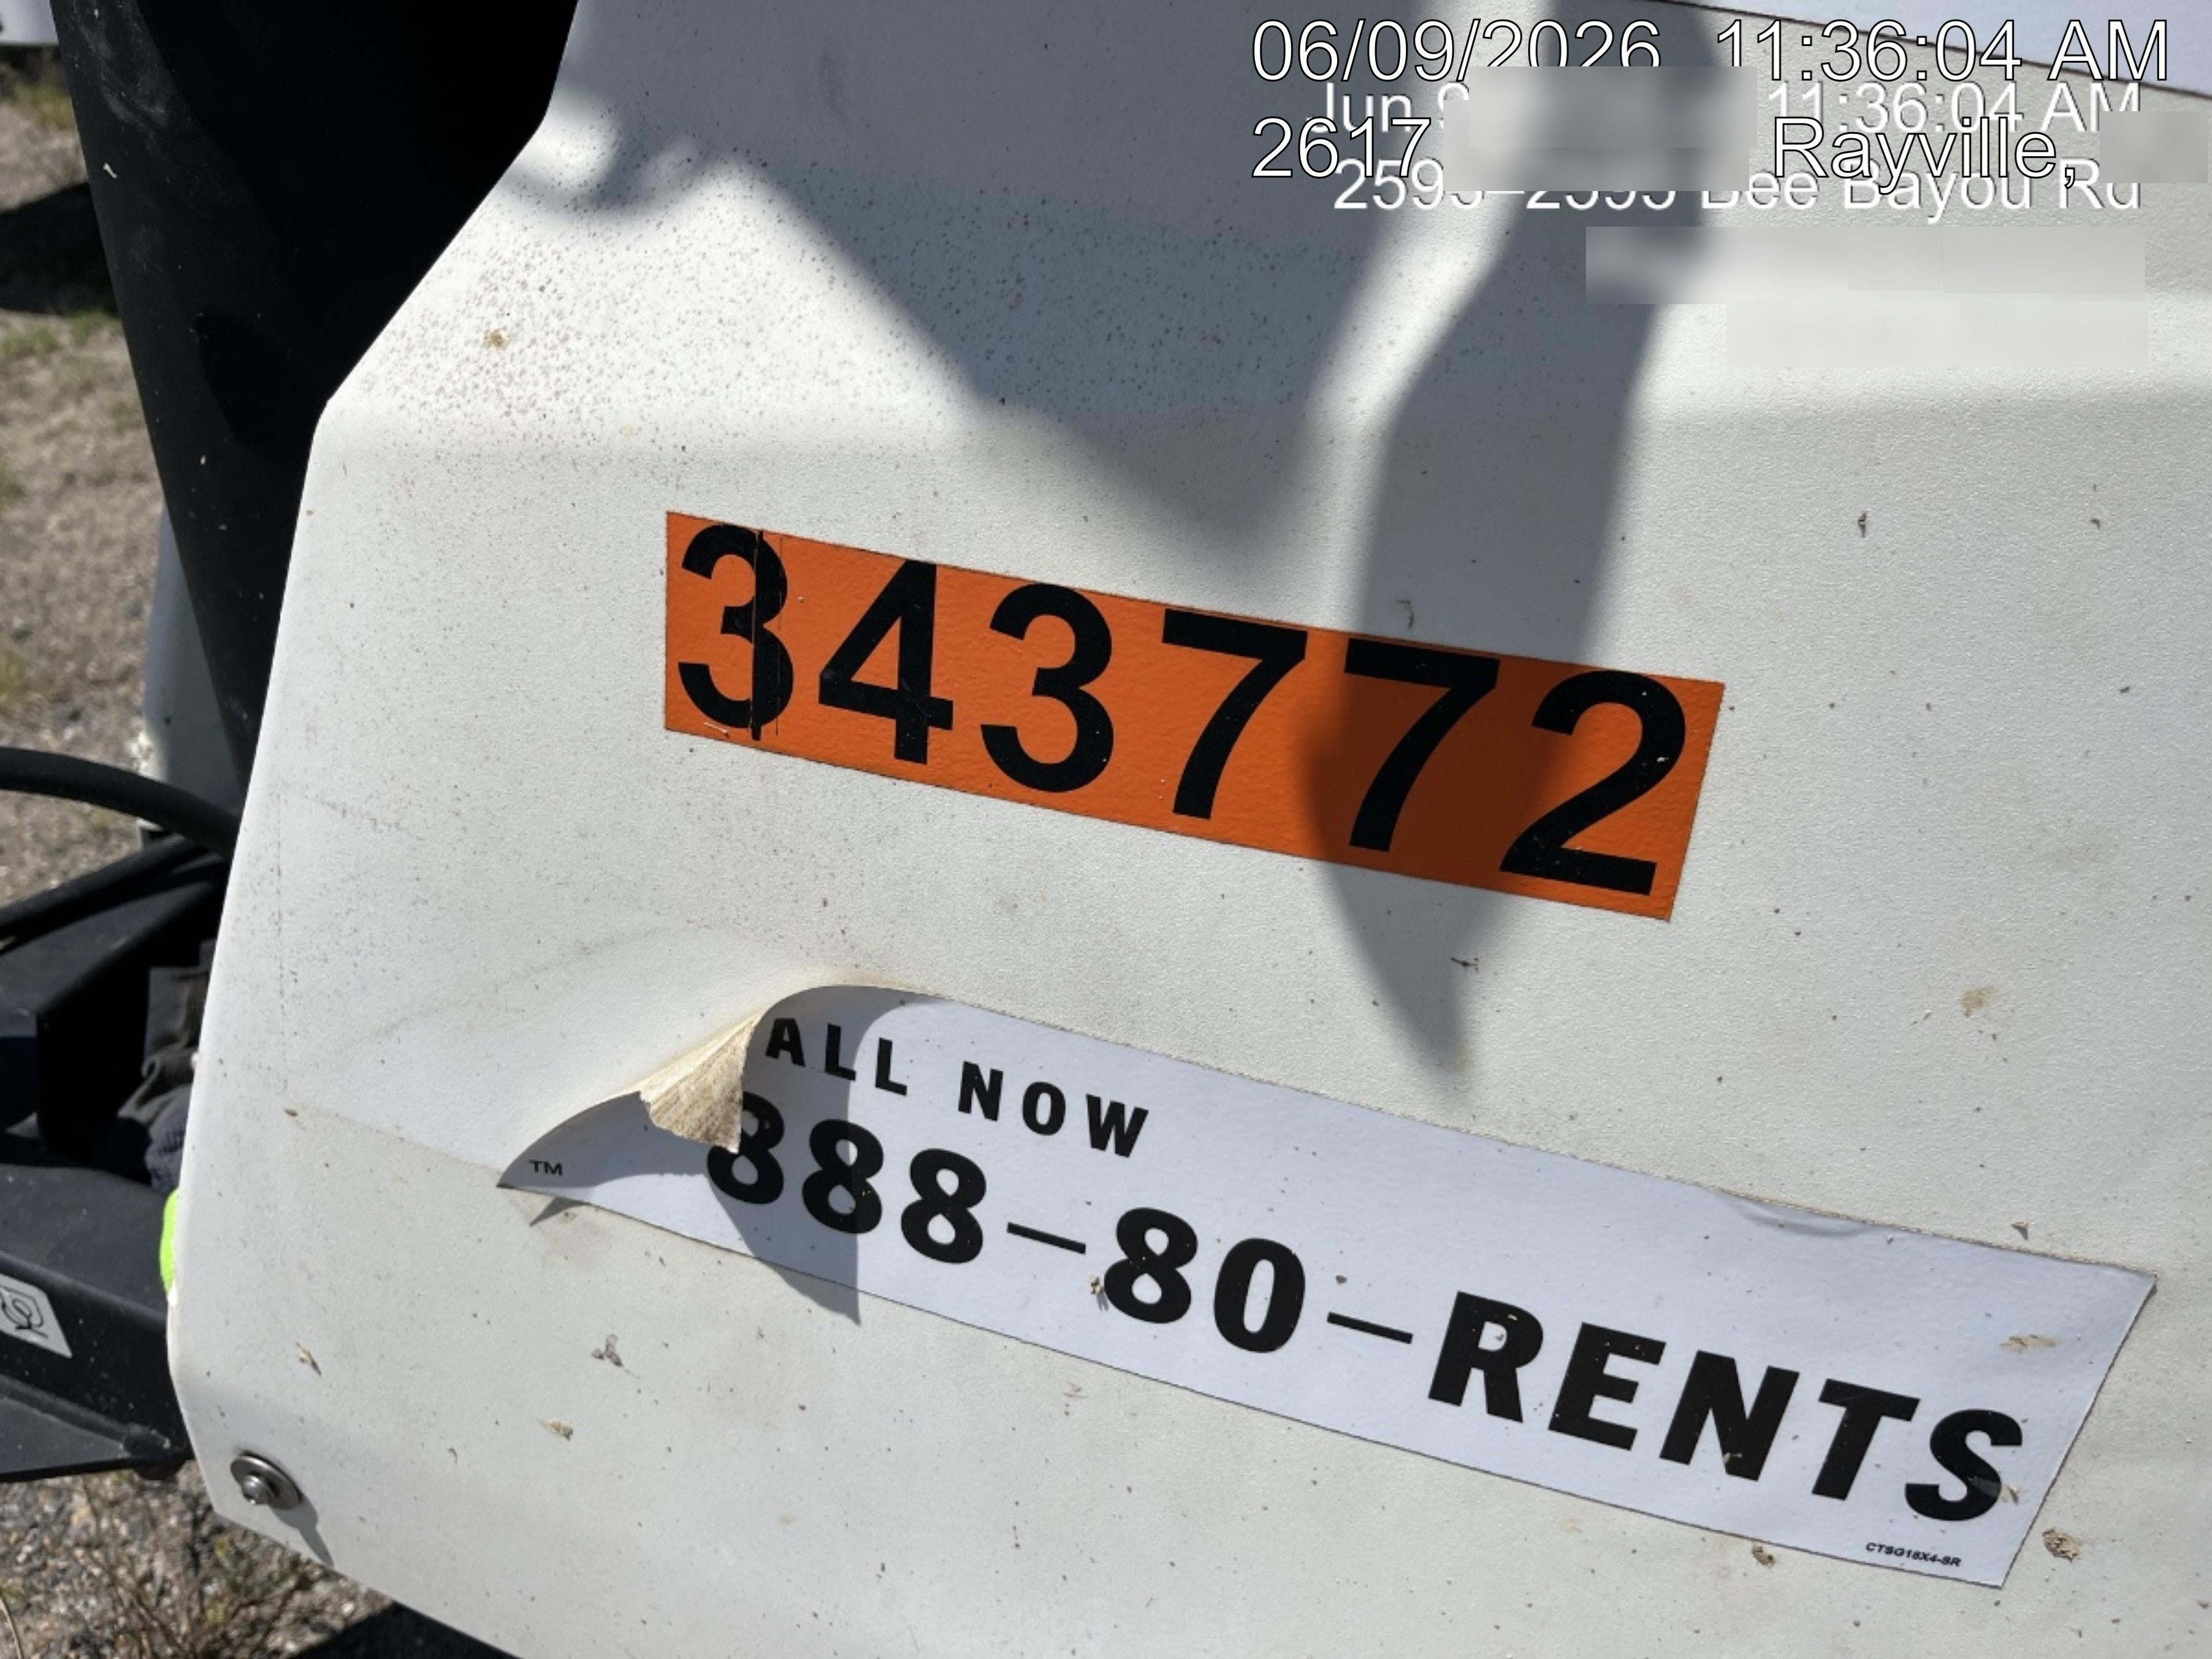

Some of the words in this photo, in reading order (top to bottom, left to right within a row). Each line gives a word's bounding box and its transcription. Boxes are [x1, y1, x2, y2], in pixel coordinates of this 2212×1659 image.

[678, 524, 1687, 896] 343772
[764, 1018, 908, 1097] ALL
[959, 1061, 1148, 1158] NOW
[529, 1159, 563, 1176] TM
